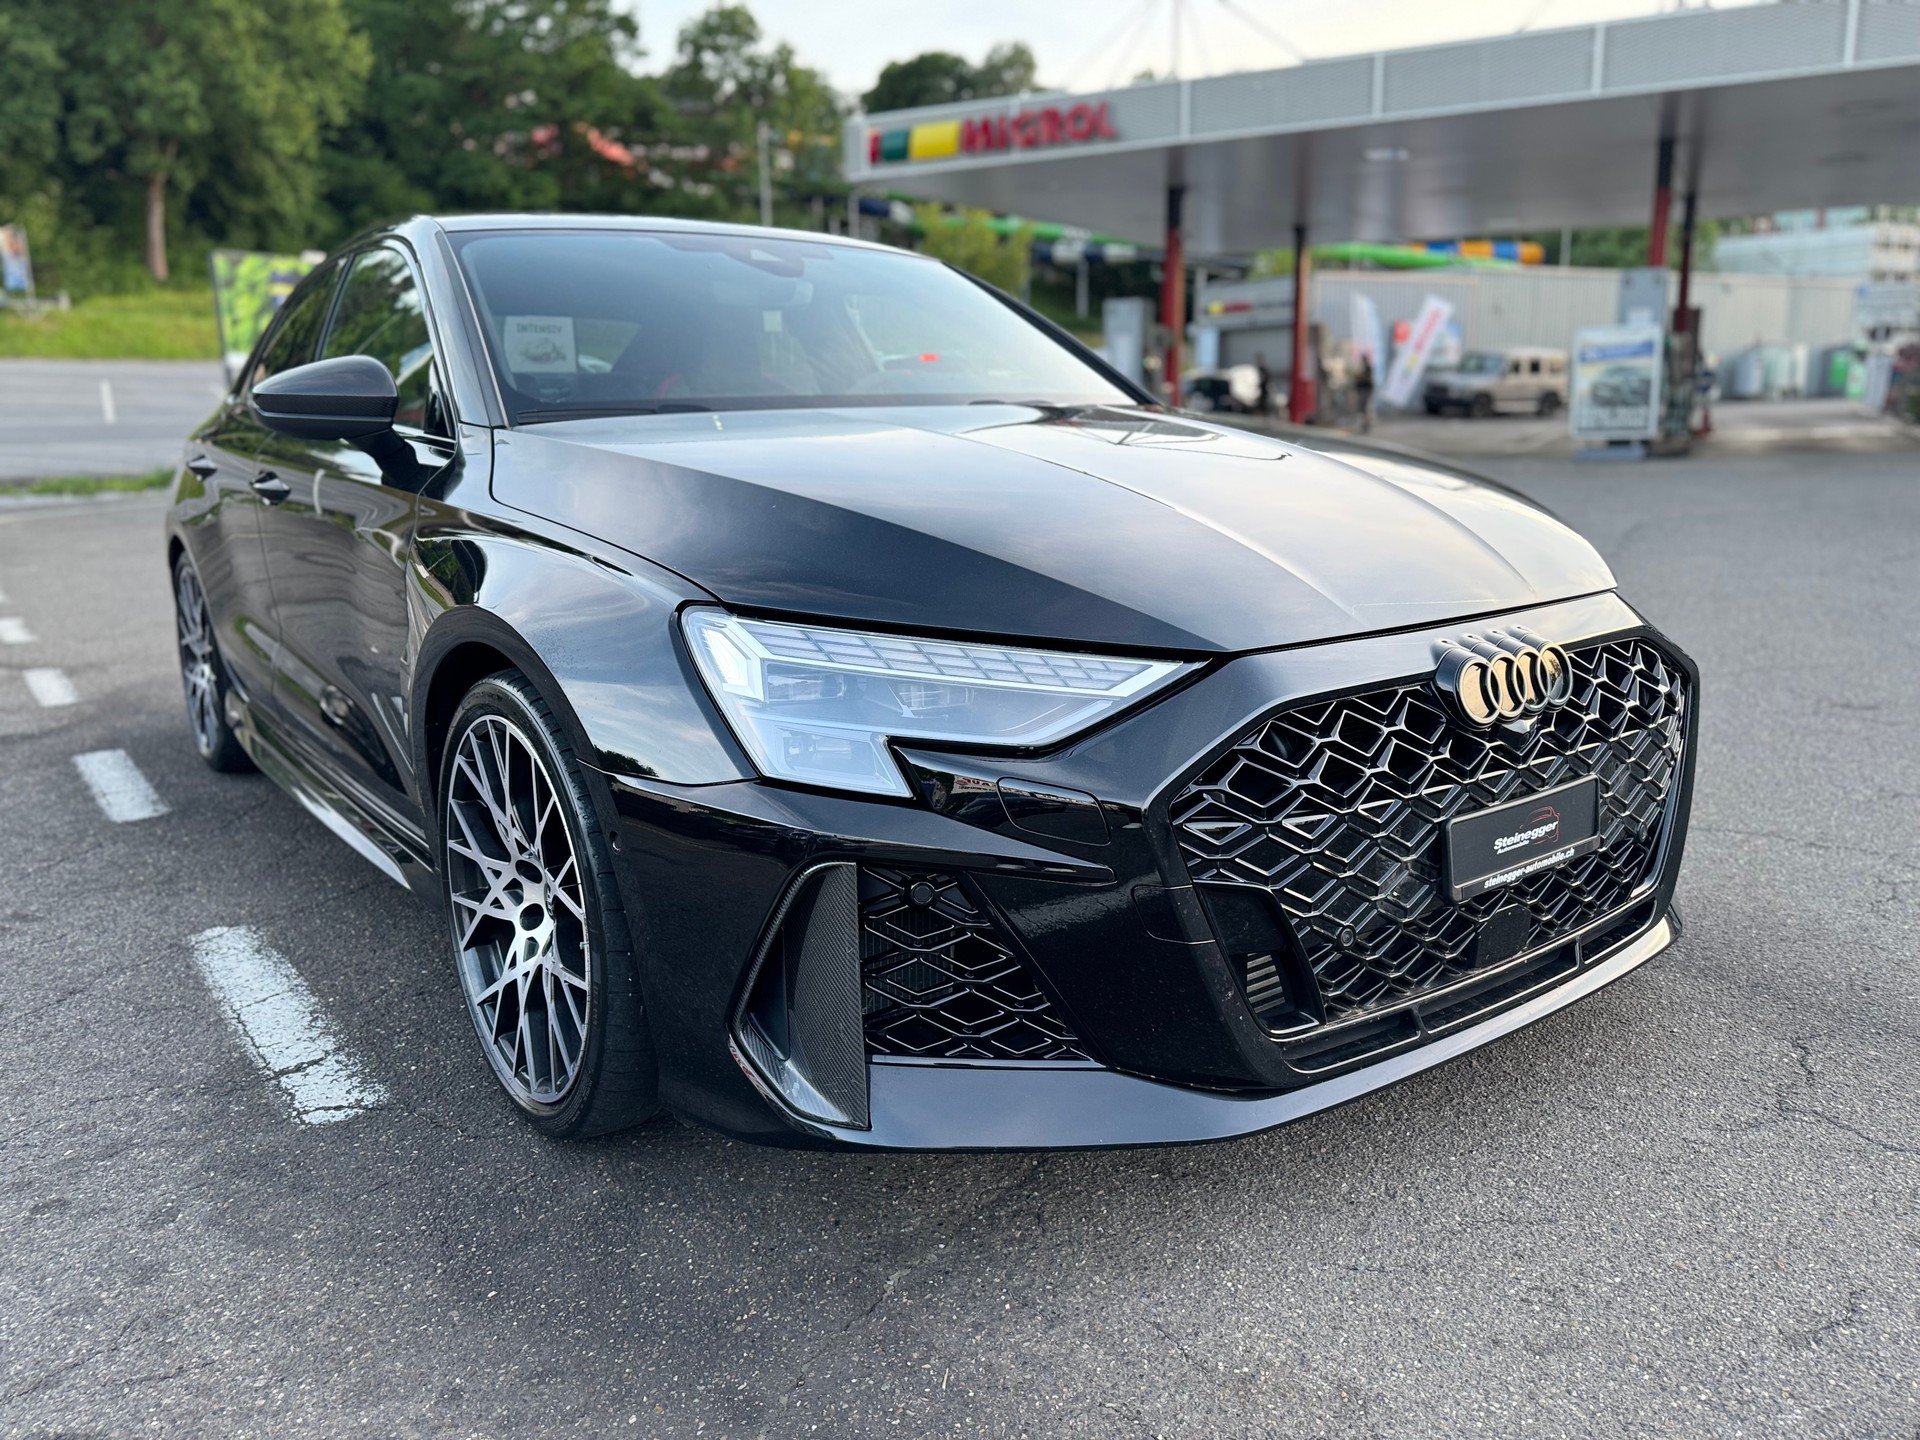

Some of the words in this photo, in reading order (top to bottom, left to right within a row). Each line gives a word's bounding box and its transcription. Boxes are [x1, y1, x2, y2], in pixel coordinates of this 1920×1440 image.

[962, 101, 1117, 153] MIGROL
[1493, 820, 1559, 850] Steinegger
[1484, 847, 1575, 888] steinegger-automobile.ch
